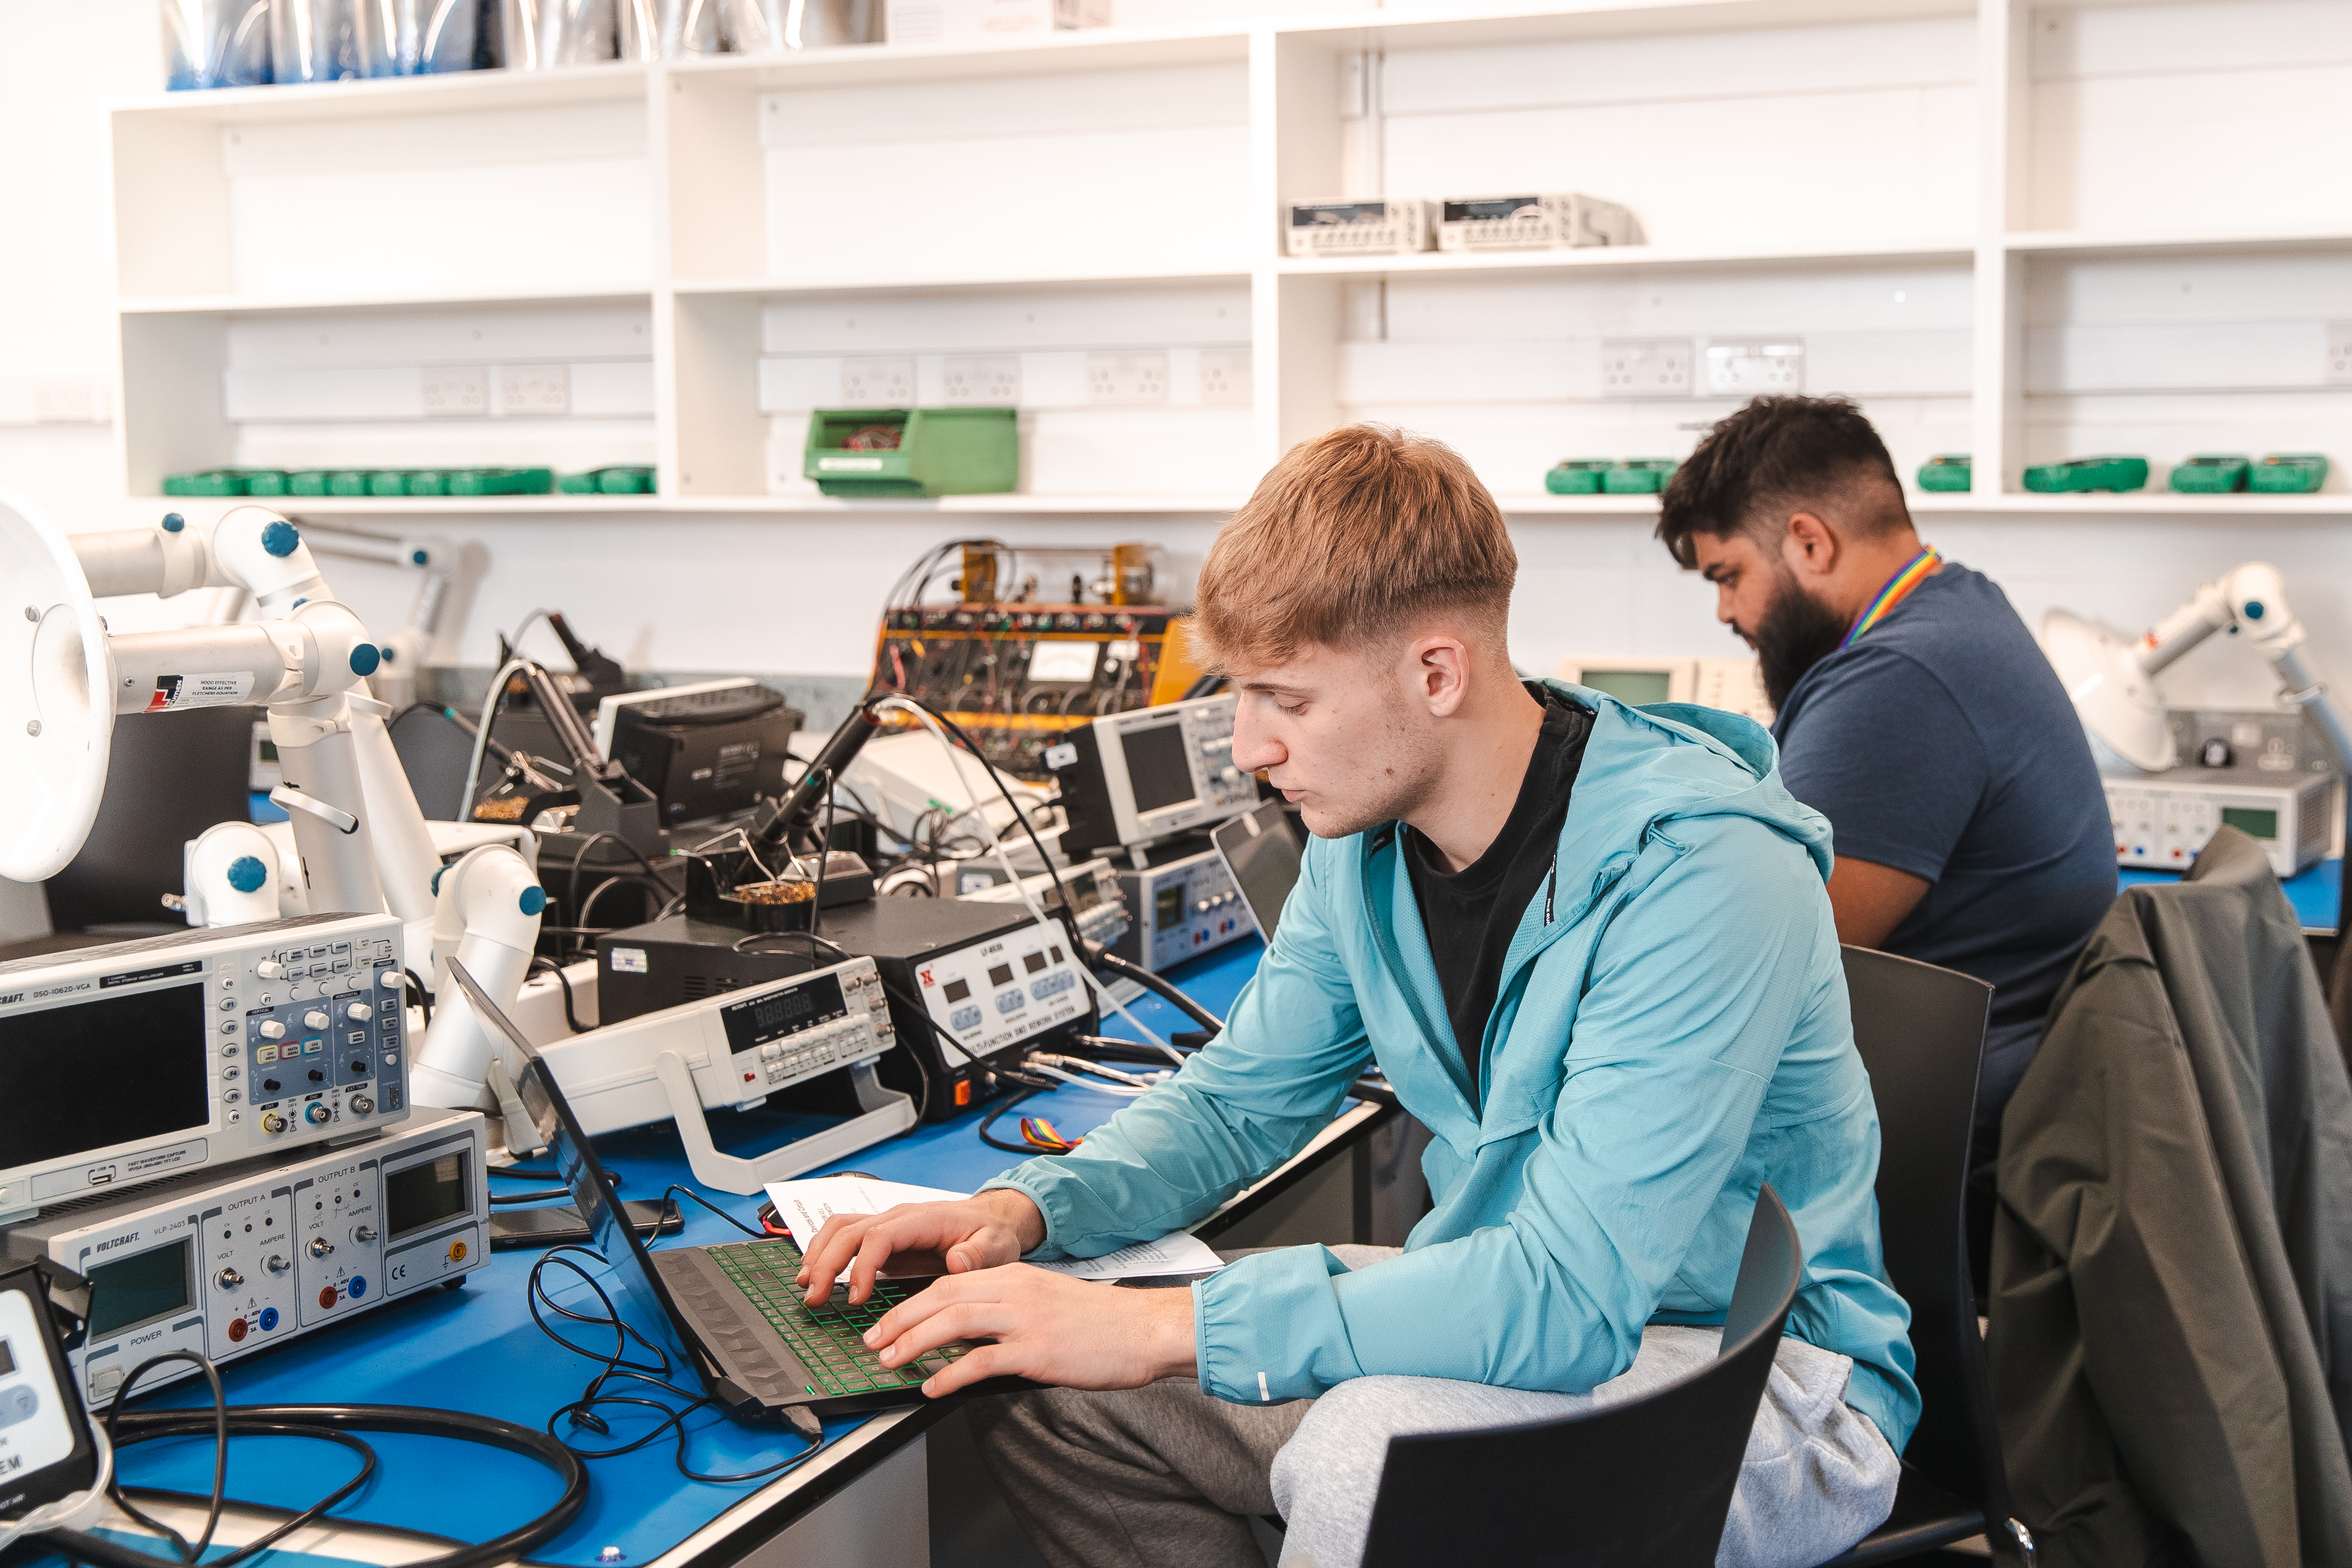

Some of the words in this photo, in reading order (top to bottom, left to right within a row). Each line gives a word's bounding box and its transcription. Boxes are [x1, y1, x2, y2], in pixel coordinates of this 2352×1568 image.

[34, 983, 91, 998] DSO-1062D-VGA
[0, 993, 24, 1005] RAFT.
[140, 1154, 166, 1164] WAVEFORM
[167, 1150, 186, 1158] CAPTURE
[318, 1168, 348, 1183] OUTPUT
[228, 1196, 258, 1211] OUTPUT
[793, 1199, 805, 1211] Circuit
[348, 1205, 373, 1218] AMPERE
[154, 1220, 185, 1235] VLP-2403
[309, 1220, 324, 1230] VOLT
[805, 1219, 818, 1232] Devices
[259, 1233, 286, 1246] AMPERE
[217, 1250, 234, 1260] VOLT
[391, 1264, 406, 1281] CE
[130, 1330, 162, 1347] POWER
